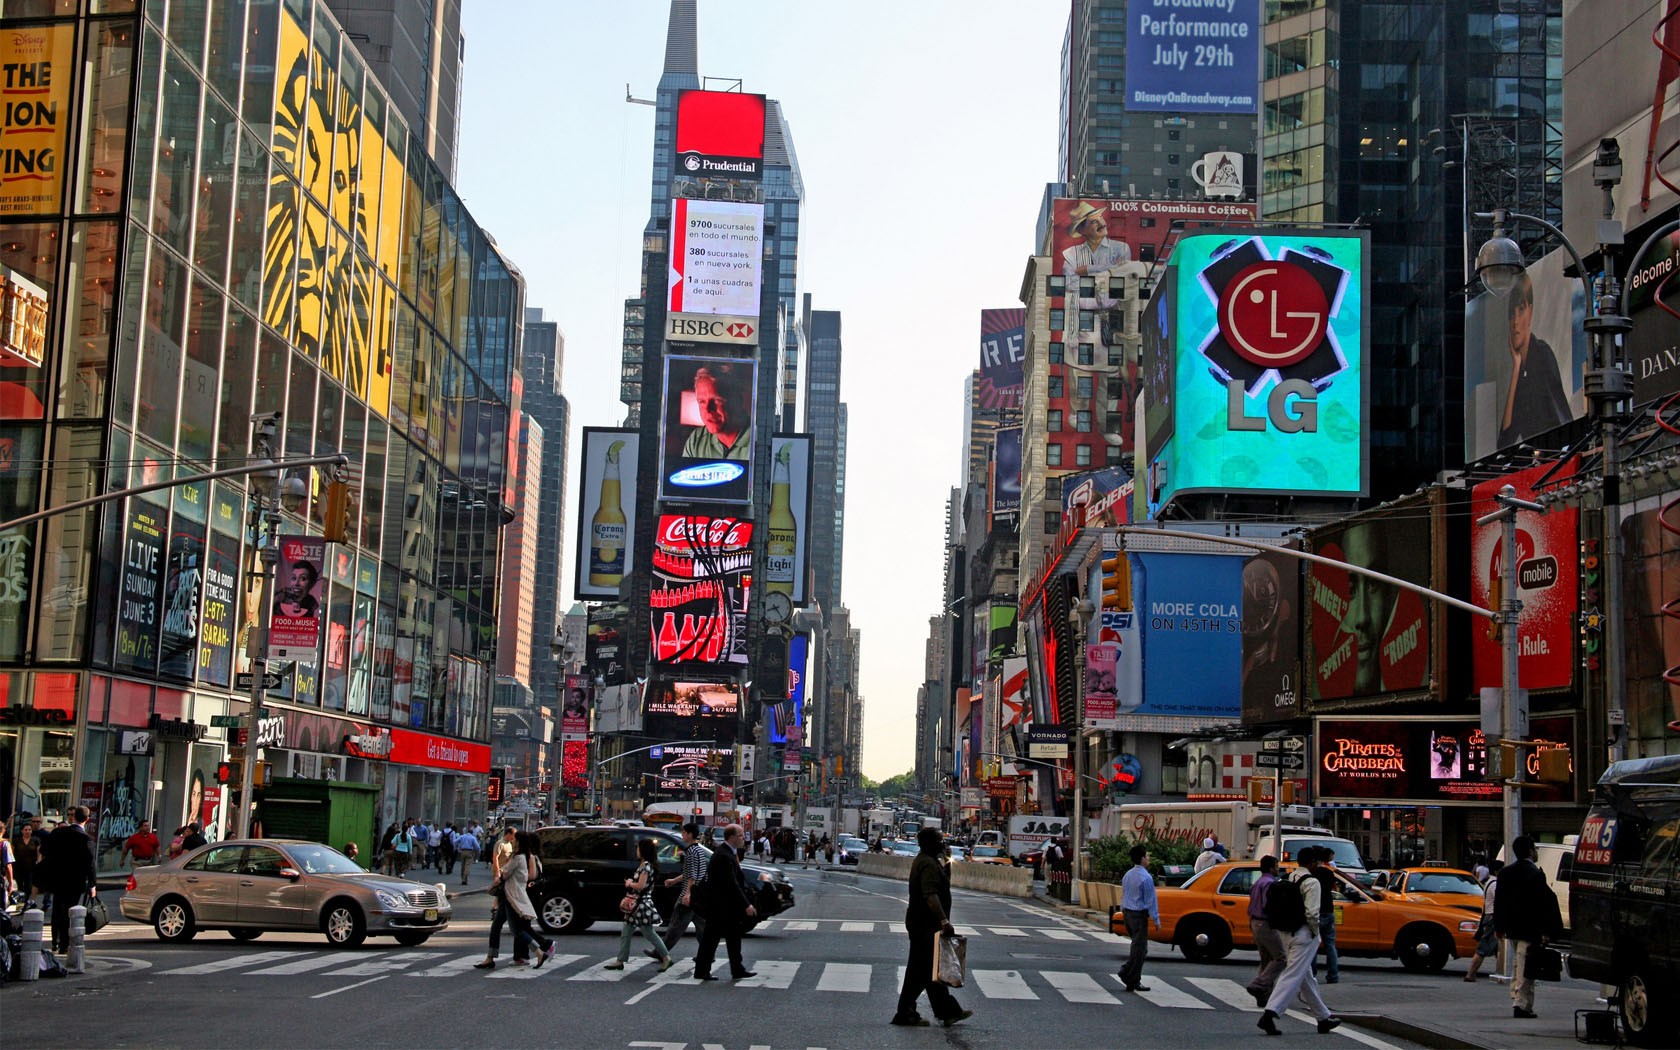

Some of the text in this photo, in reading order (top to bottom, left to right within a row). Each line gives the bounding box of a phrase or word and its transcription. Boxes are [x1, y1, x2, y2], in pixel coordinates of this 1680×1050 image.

[1140, 14, 1248, 38] Performance
[1153, 42, 1234, 71] July 29th
[3, 61, 51, 88] THE
[1134, 90, 1252, 107] DisneyOnBroadway.com
[0, 101, 56, 127] ION
[0, 148, 54, 175] ING
[702, 159, 756, 173] Prudential
[1110, 202, 1248, 216] 100% Colombian Coffee
[690, 220, 755, 232] 9700 sucursales
[701, 232, 719, 240] todo
[721, 232, 729, 240] el
[731, 233, 761, 242] mundo.
[689, 247, 749, 259] 380 sucursales
[706, 261, 728, 269] nueva
[687, 275, 692, 283] 1
[721, 279, 753, 288] cuadras
[692, 286, 703, 295] de
[671, 319, 724, 338] HSBC
[1227, 378, 1318, 434] LG
[680, 470, 734, 481] SAMSUNG
[594, 523, 624, 535] Corona
[128, 538, 159, 575] LIVE
[288, 543, 323, 557] TASTE
[207, 567, 234, 588] FOR A GOOD
[1523, 562, 1553, 583] mobile
[126, 573, 157, 599] SUNDAY
[206, 582, 217, 598] TIME
[123, 600, 155, 625] JUNE 3
[1152, 601, 1239, 618] MORE COLA
[163, 608, 197, 639] AWARDS
[274, 617, 316, 628] FOOD MUSIC
[1151, 617, 1174, 630] ON
[1180, 618, 1220, 632] 45TH
[1523, 634, 1550, 656] Rule.
[201, 647, 212, 668] 07
[427, 739, 436, 759] Get
[440, 741, 453, 763] friend
[458, 749, 469, 767] open
[664, 747, 684, 755] 100,000
[1334, 738, 1395, 757] PIRATES
[1324, 752, 1406, 772] CARIBBEAN
[1581, 819, 1617, 848] FOX 5
[1577, 849, 1611, 863] NEWS
